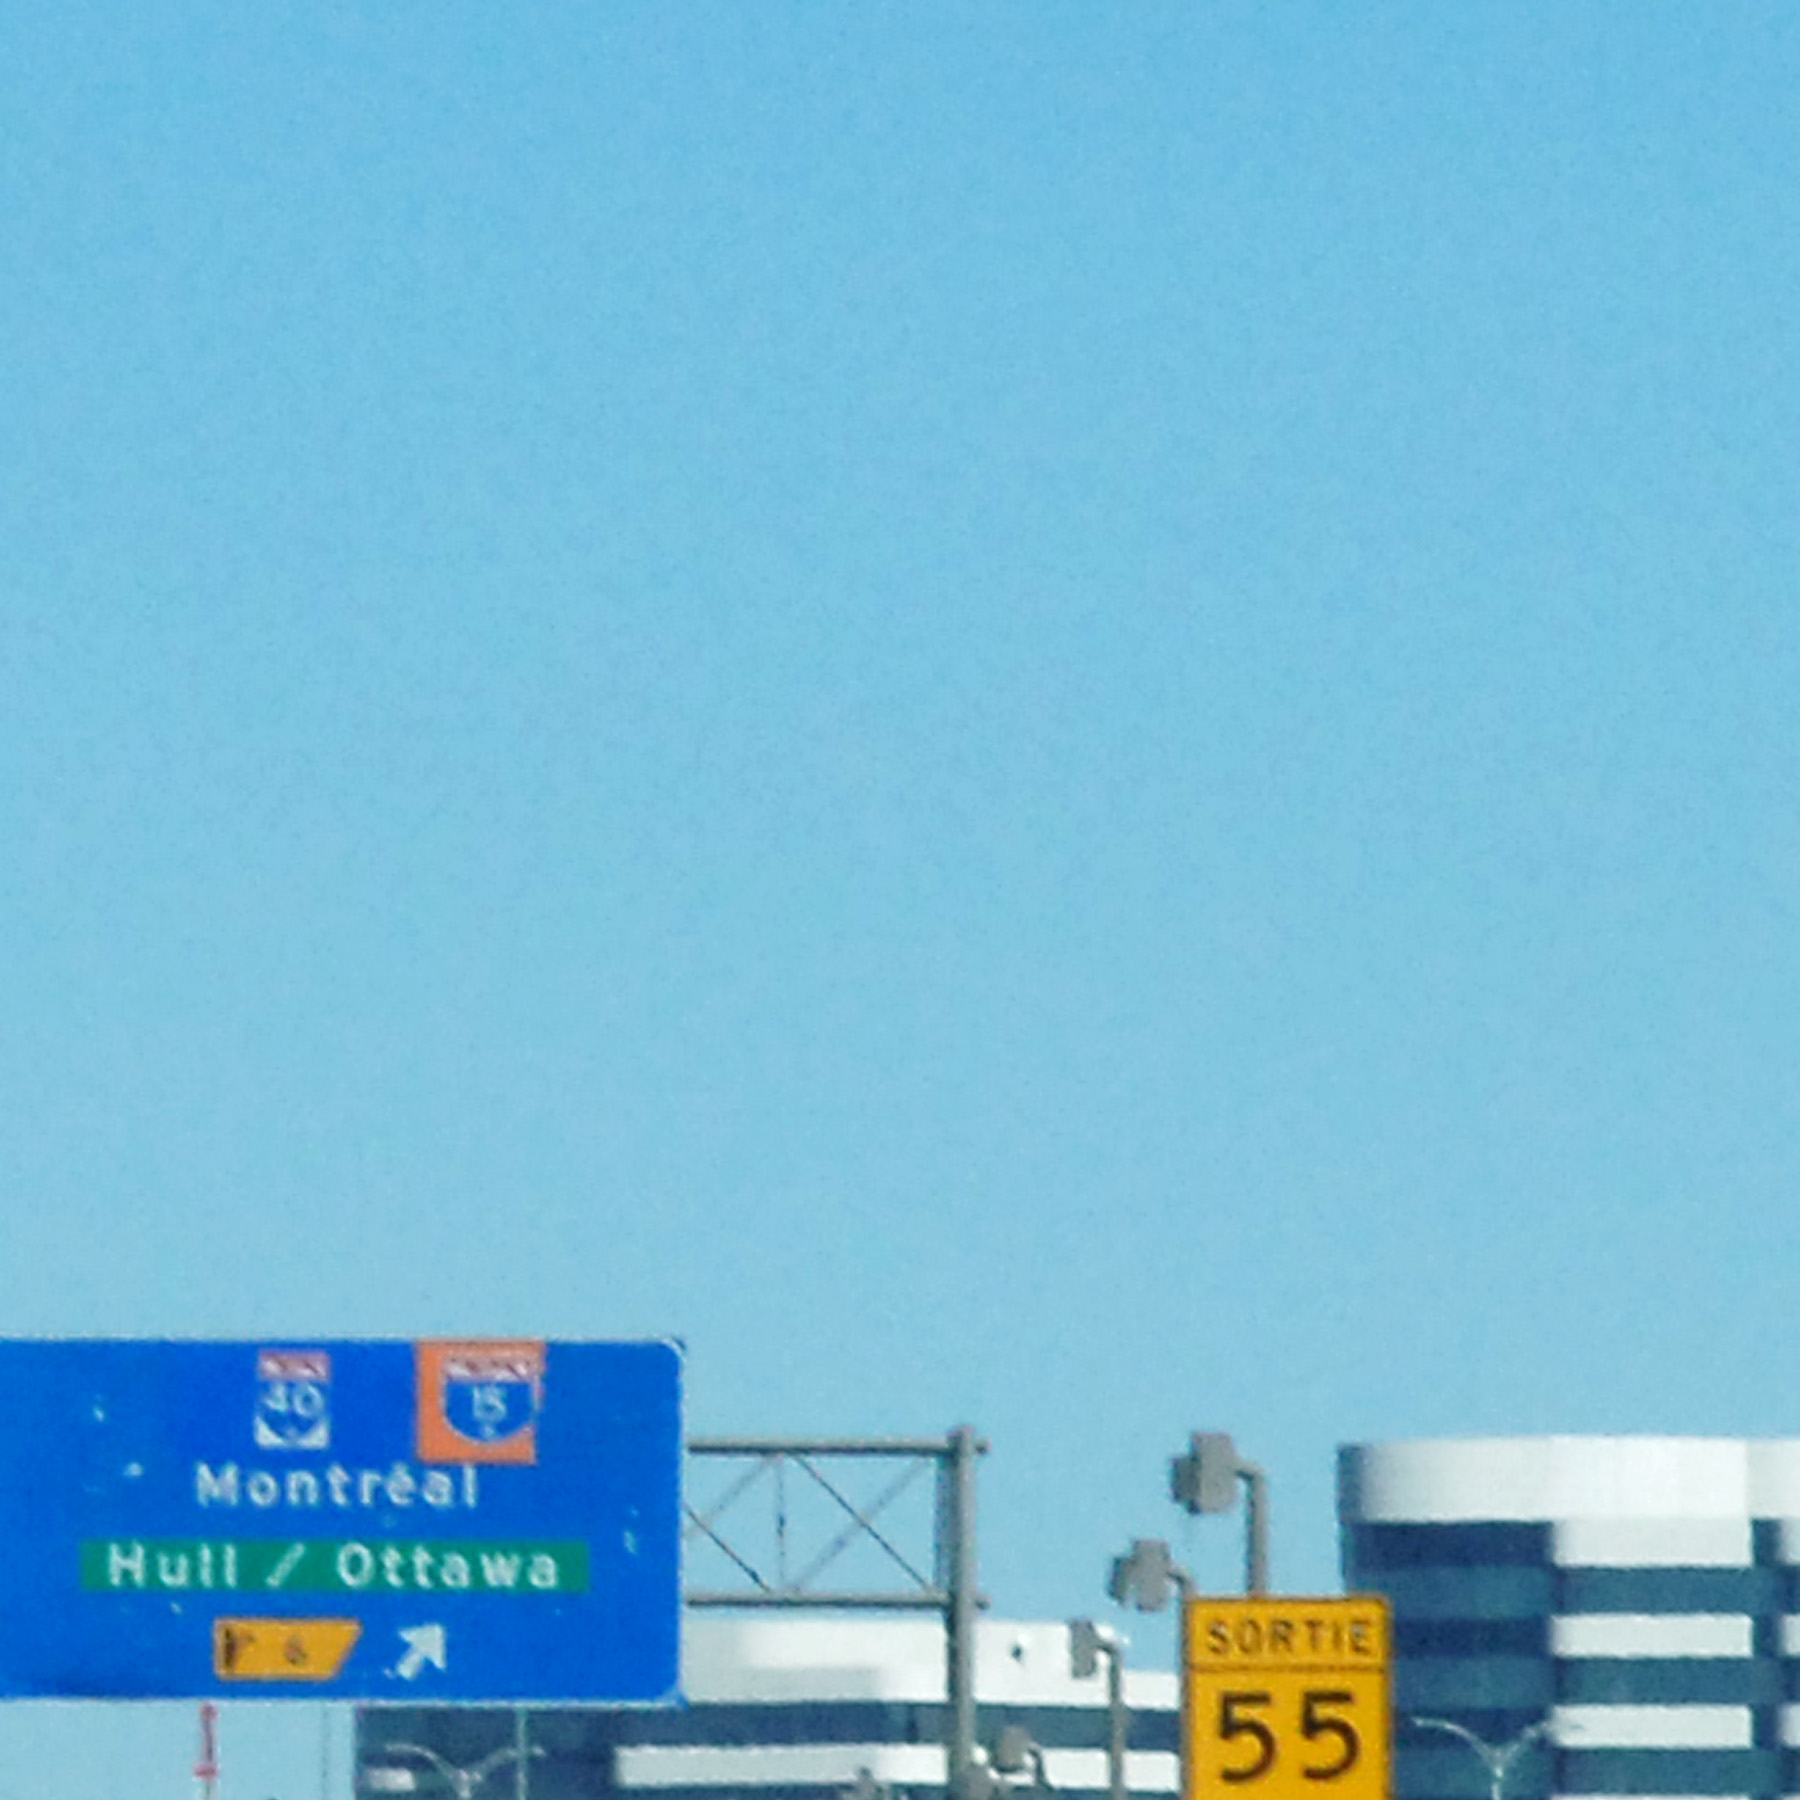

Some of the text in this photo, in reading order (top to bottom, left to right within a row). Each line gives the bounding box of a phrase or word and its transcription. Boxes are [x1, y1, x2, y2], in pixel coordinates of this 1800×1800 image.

[194, 1461, 479, 1508] Montréal
[107, 1542, 237, 1588] Hull
[336, 1542, 559, 1589] Ottawa
[1207, 1620, 1374, 1657] SORTIE
[1218, 1690, 1360, 1785] 55
